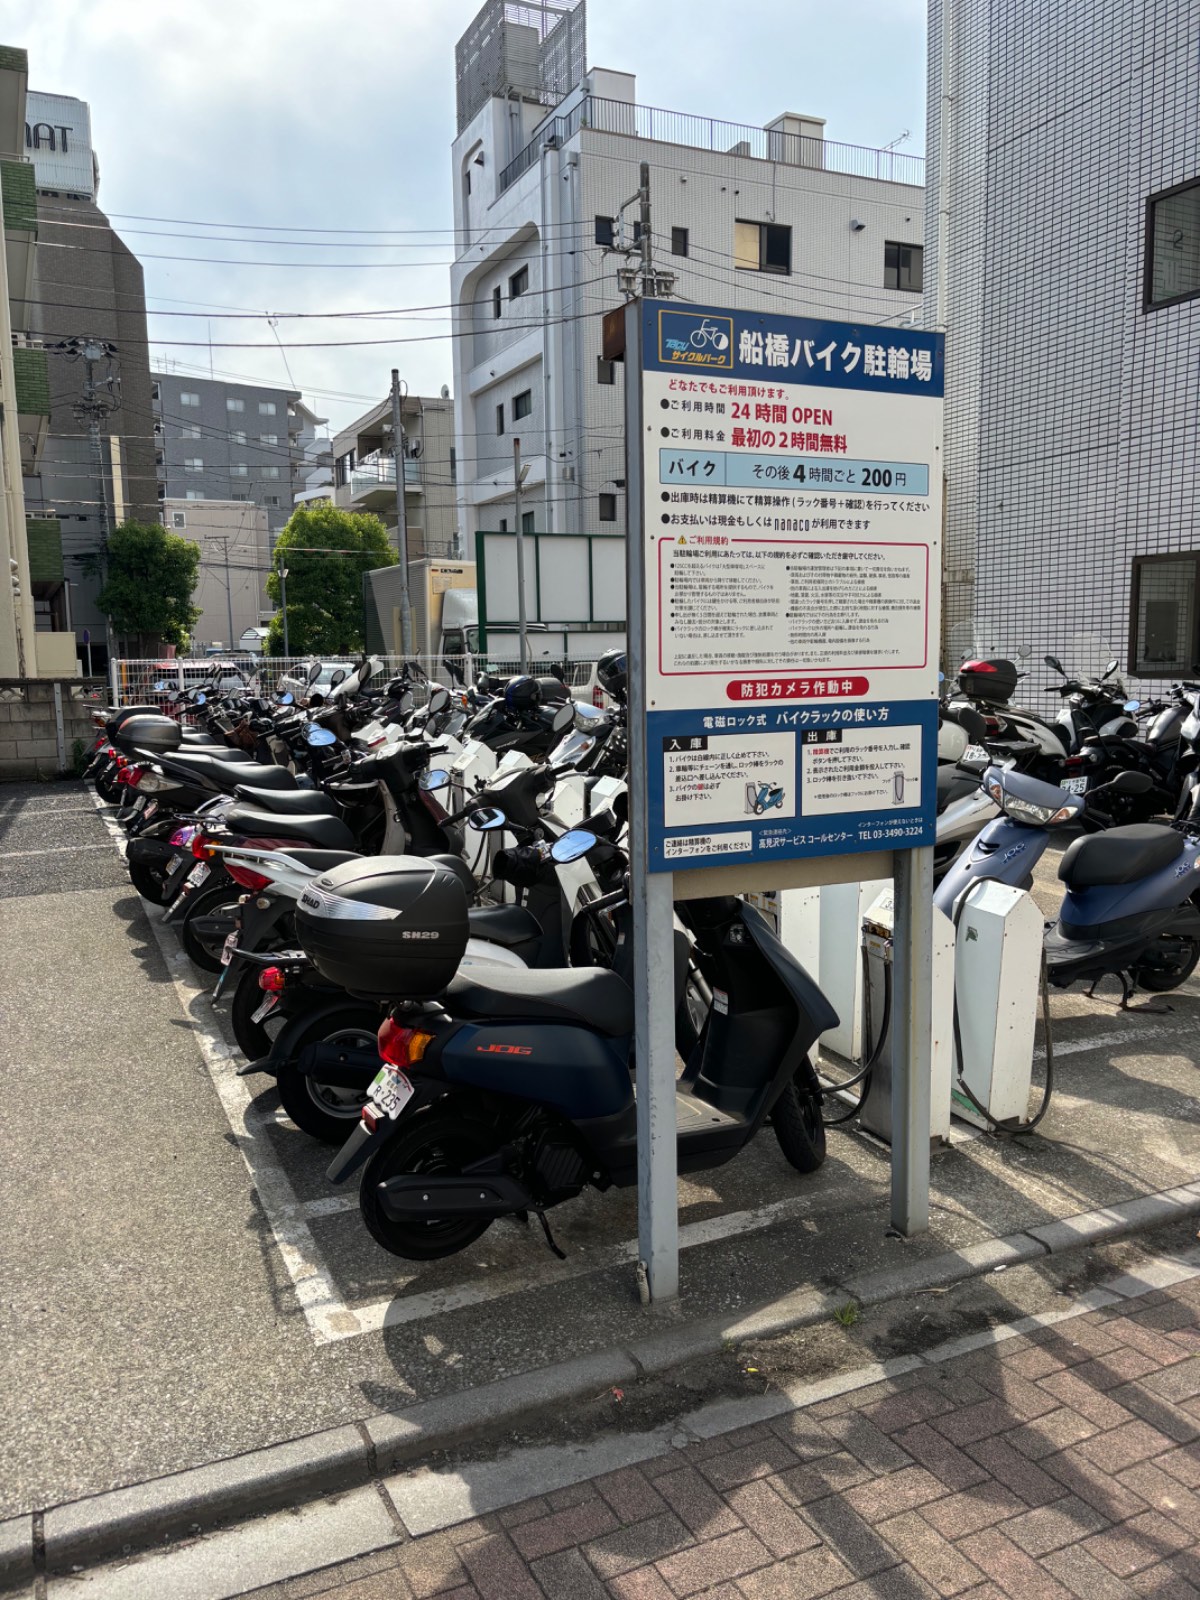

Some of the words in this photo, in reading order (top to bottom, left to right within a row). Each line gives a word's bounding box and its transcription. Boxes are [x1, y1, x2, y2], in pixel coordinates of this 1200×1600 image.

[738, 329, 933, 382] 船橋バイク駐輪場
[668, 379, 790, 400] どなたでもご利用頂けます。
[670, 399, 726, 414] ご利用時間
[792, 406, 833, 426] OPEN
[670, 427, 726, 442] ご利用料金
[669, 459, 716, 477] バイク
[689, 535, 729, 546] ご利用規約
[741, 679, 853, 698] 防犯カメラ作動中
[703, 714, 767, 729] 電磁ロック式
[776, 707, 889, 725] バイクラックの使い方
[858, 830, 872, 840] TEL
[873, 826, 923, 839] 03-3490-3224
[402, 931, 440, 939] SH29
[477, 1044, 533, 1055] JOG
